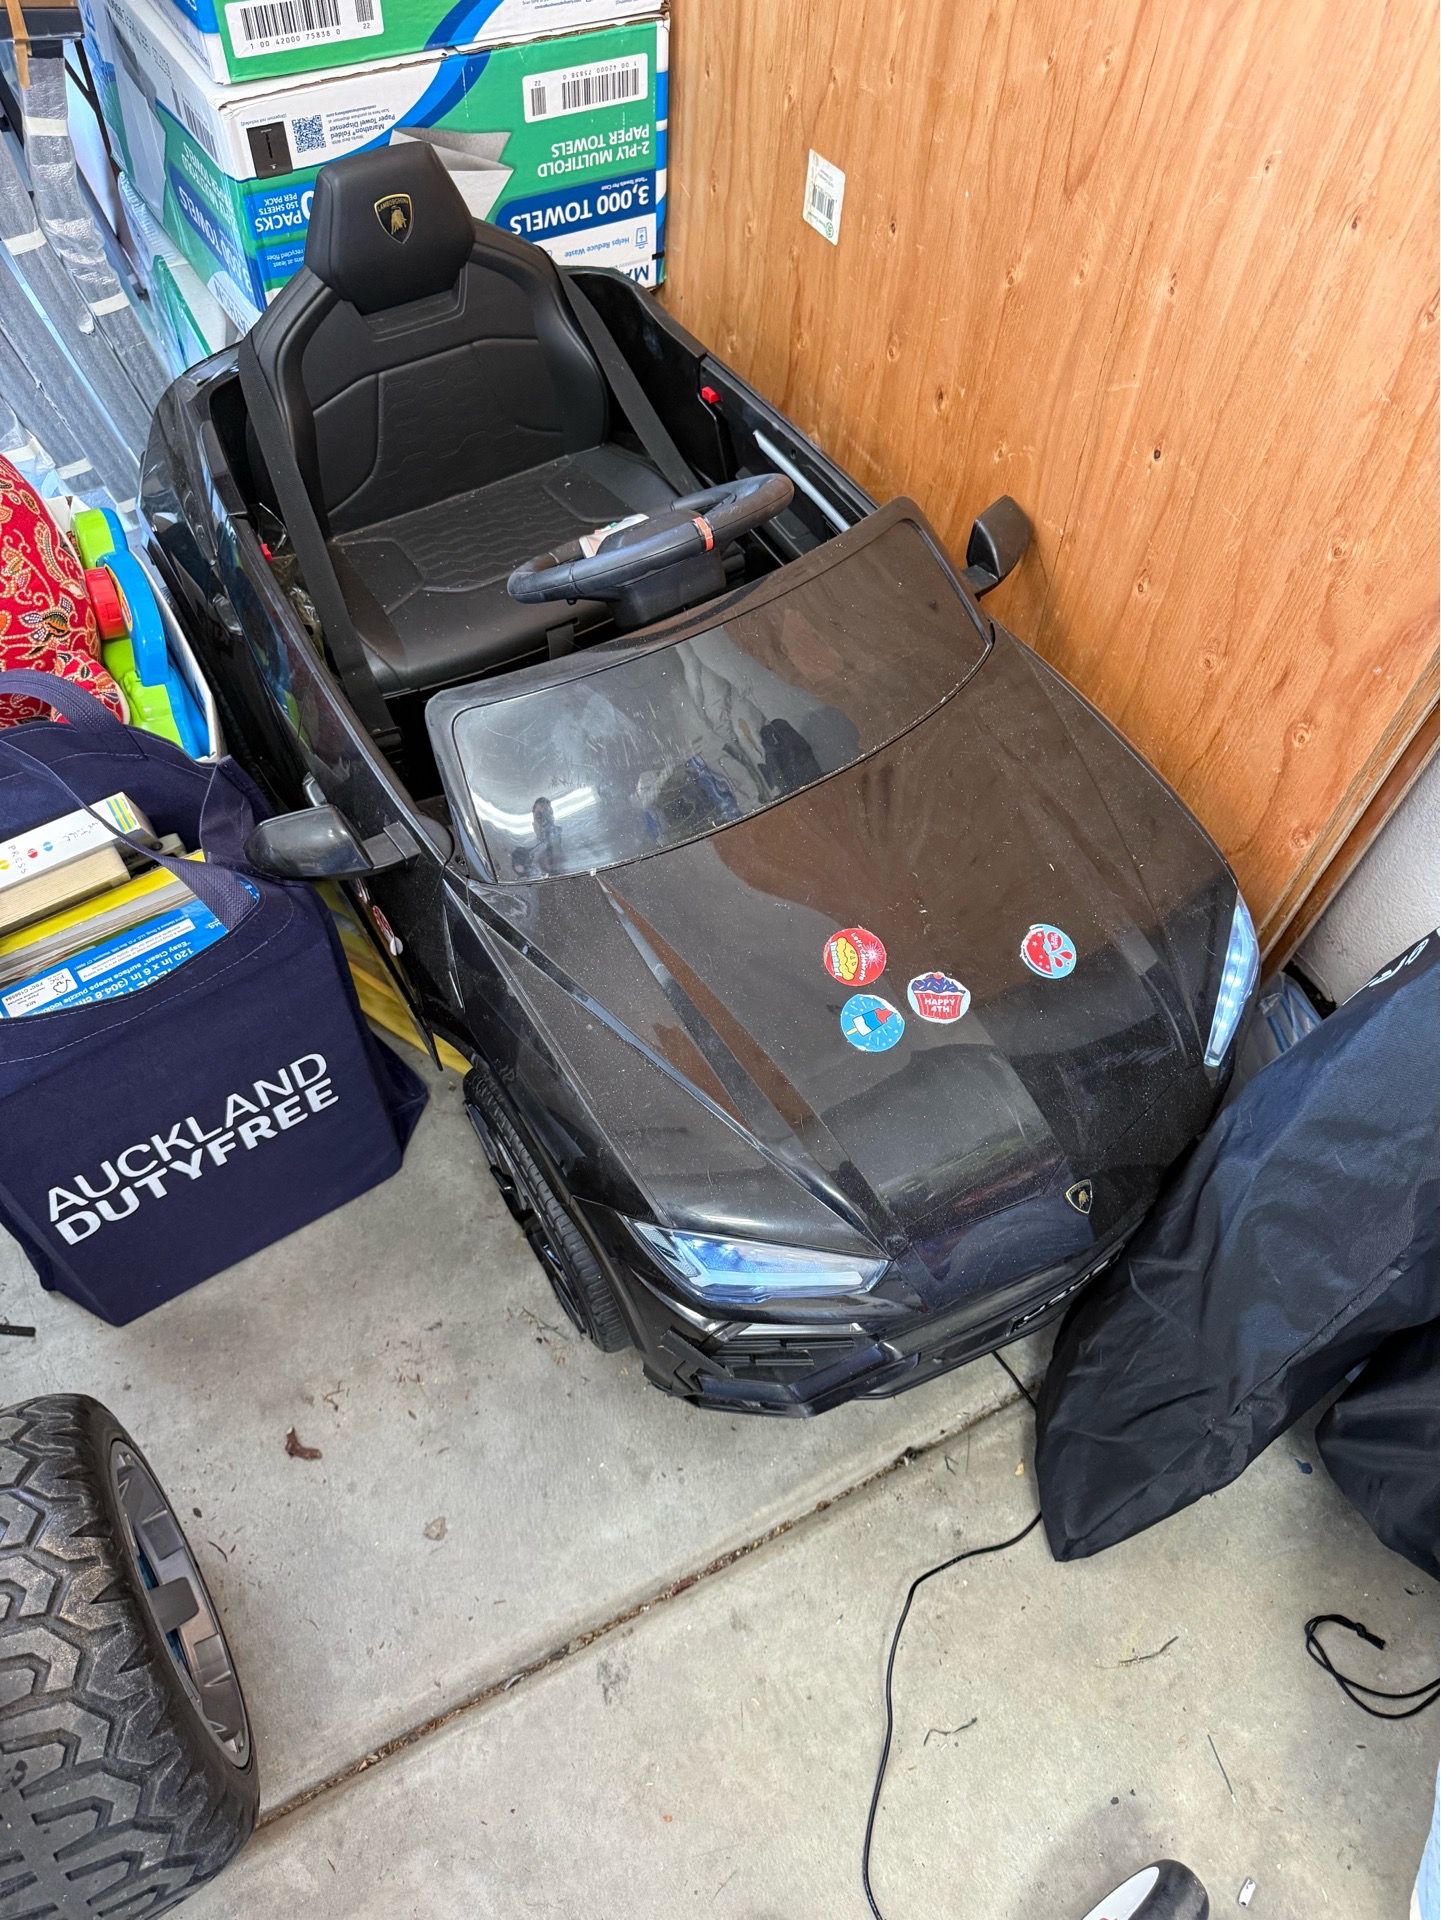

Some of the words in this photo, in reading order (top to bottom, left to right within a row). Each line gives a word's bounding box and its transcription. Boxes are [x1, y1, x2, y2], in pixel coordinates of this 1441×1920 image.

[276, 35, 300, 45] 42000
[306, 31, 330, 40] 75838
[571, 68, 591, 78] 75838
[596, 64, 616, 74] 42000
[359, 117, 377, 125] Towel
[378, 113, 395, 122] Paper
[328, 120, 358, 131] Dispenser
[330, 130, 350, 139] Folded
[609, 124, 650, 145] PAPER
[551, 134, 604, 158] TOWELS
[616, 141, 650, 160] 2-PLY
[538, 150, 612, 177] MULTIFOLD
[263, 195, 282, 206] PACK
[283, 192, 297, 201] PER
[597, 186, 649, 214] 3,000
[258, 204, 284, 215] SHEETS
[285, 200, 298, 209] 150
[253, 209, 302, 232] PACKS
[510, 200, 593, 234] TOWELS
[586, 241, 610, 252] Reduce
[612, 237, 629, 249] Helps
[564, 246, 585, 257] Waste
[172, 946, 194, 961] 120
[850, 932, 862, 947] Let's
[858, 948, 866, 980] Celebrate
[160, 956, 172, 967] in
[112, 962, 142, 979] surface
[130, 971, 142, 982] in
[88, 975, 113, 991] keeps
[93, 976, 129, 1000] (304.8
[62, 987, 89, 1004] puzzle
[930, 1005, 950, 1013] 4TH
[48, 1052, 328, 1222] AUCKLAND
[55, 1077, 339, 1246] DUTYFREE
